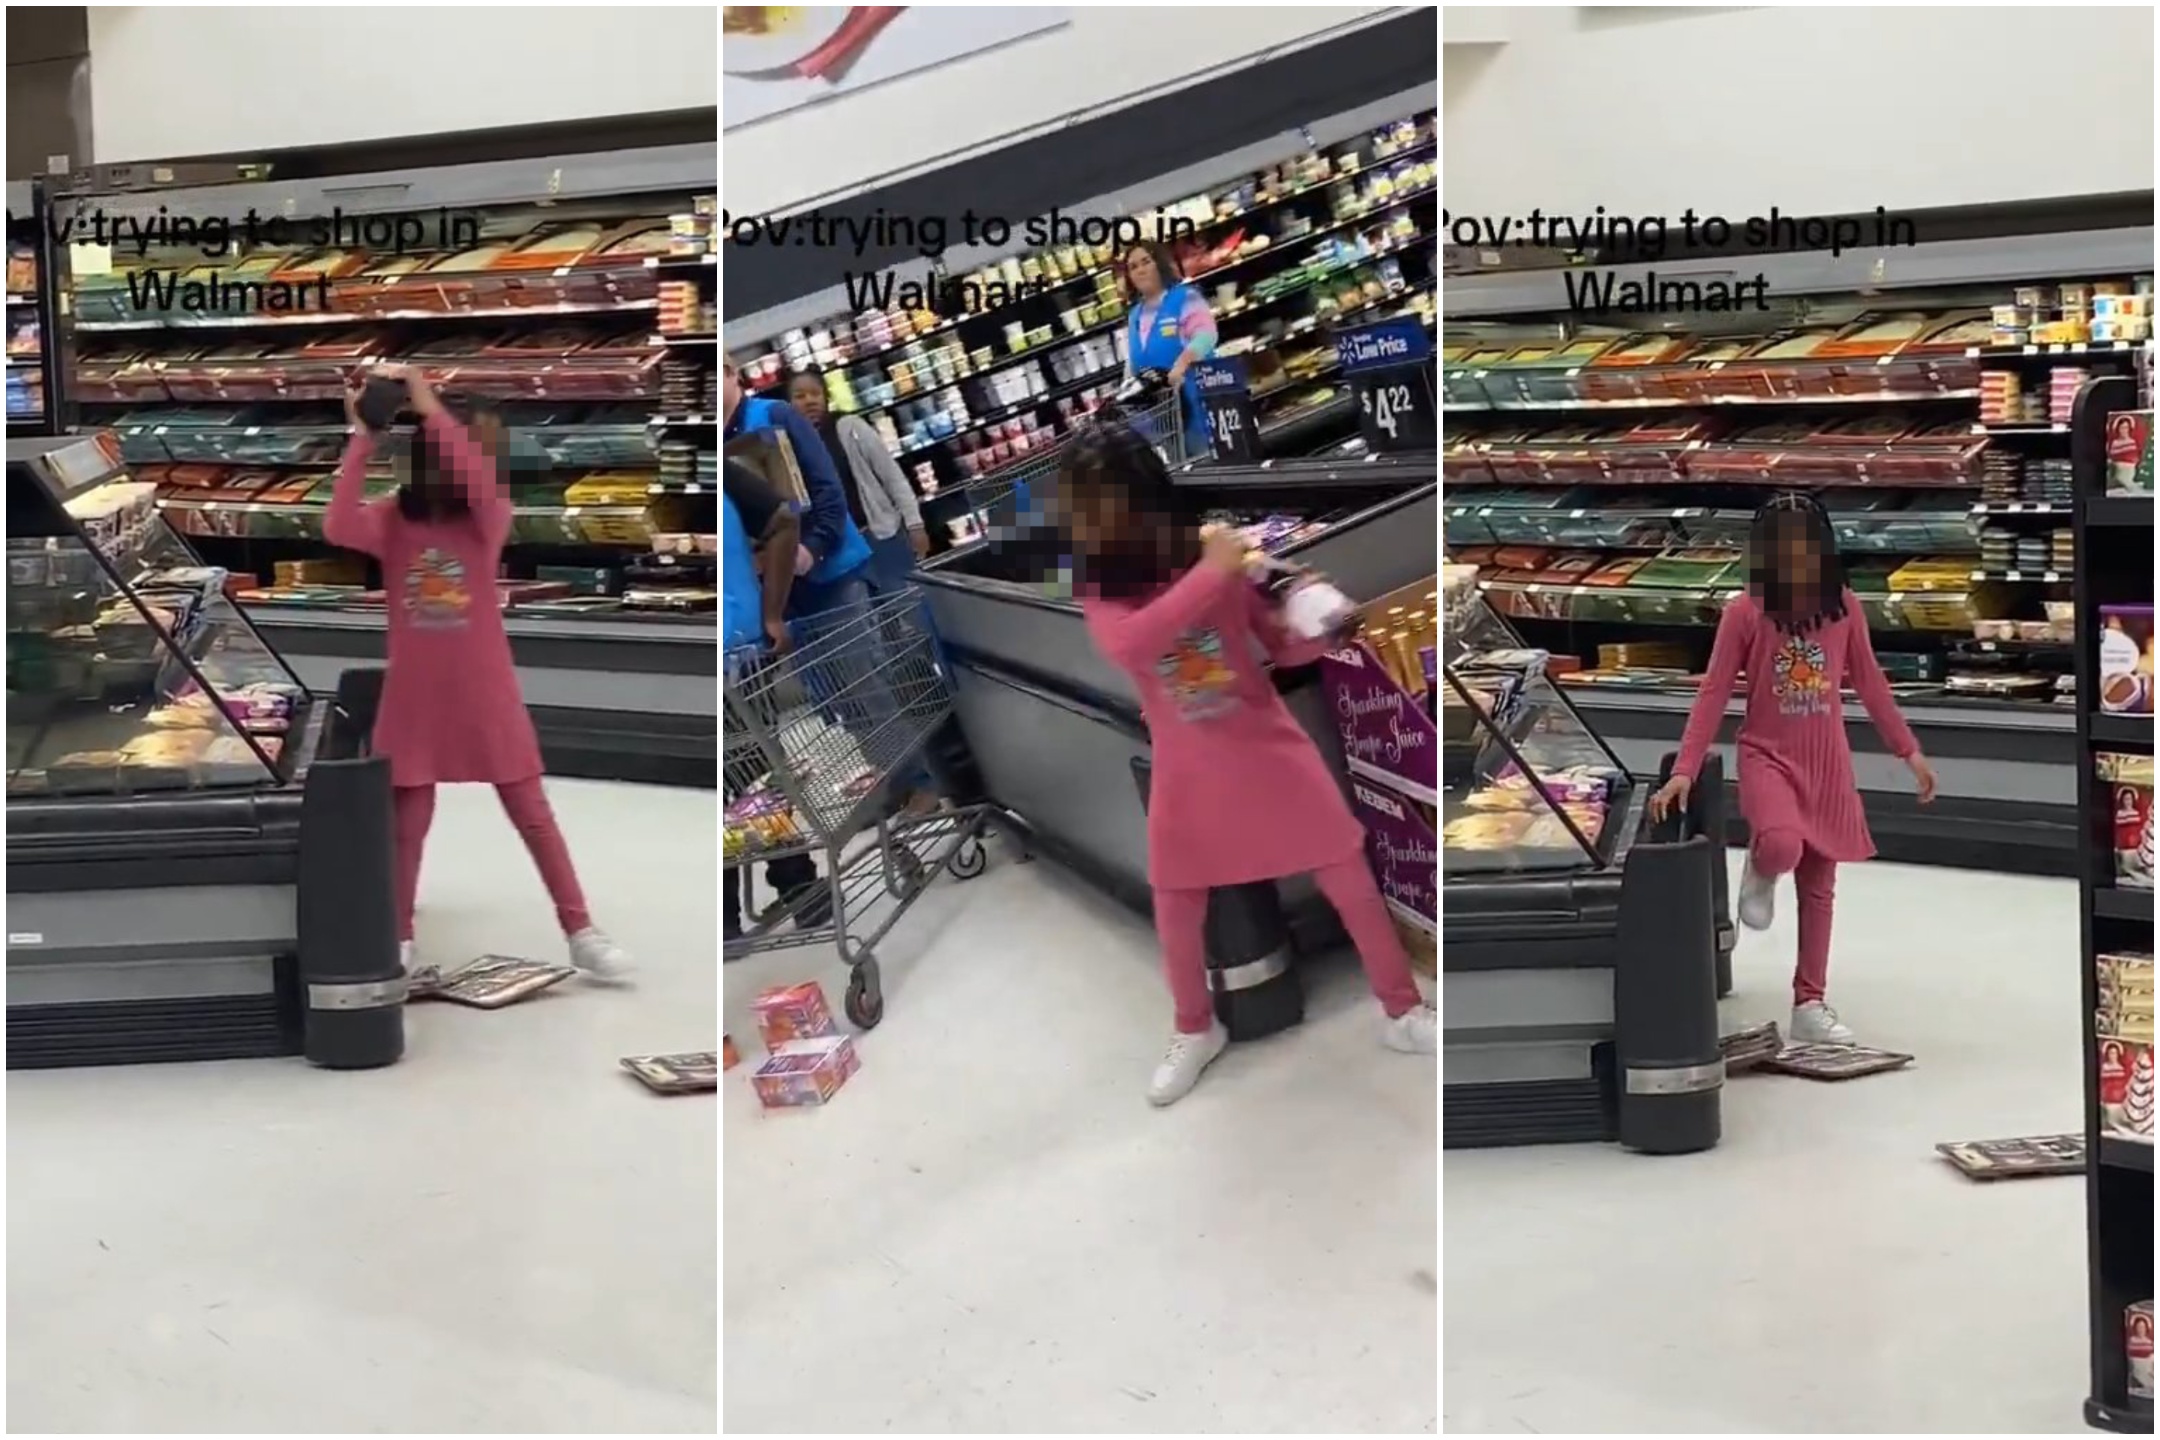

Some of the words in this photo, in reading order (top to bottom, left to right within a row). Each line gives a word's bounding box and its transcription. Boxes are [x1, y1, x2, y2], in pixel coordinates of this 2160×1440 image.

[1378, 335, 1408, 357] Price
[1338, 682, 1404, 726] Sparkling
[1386, 715, 1425, 764] Juice
